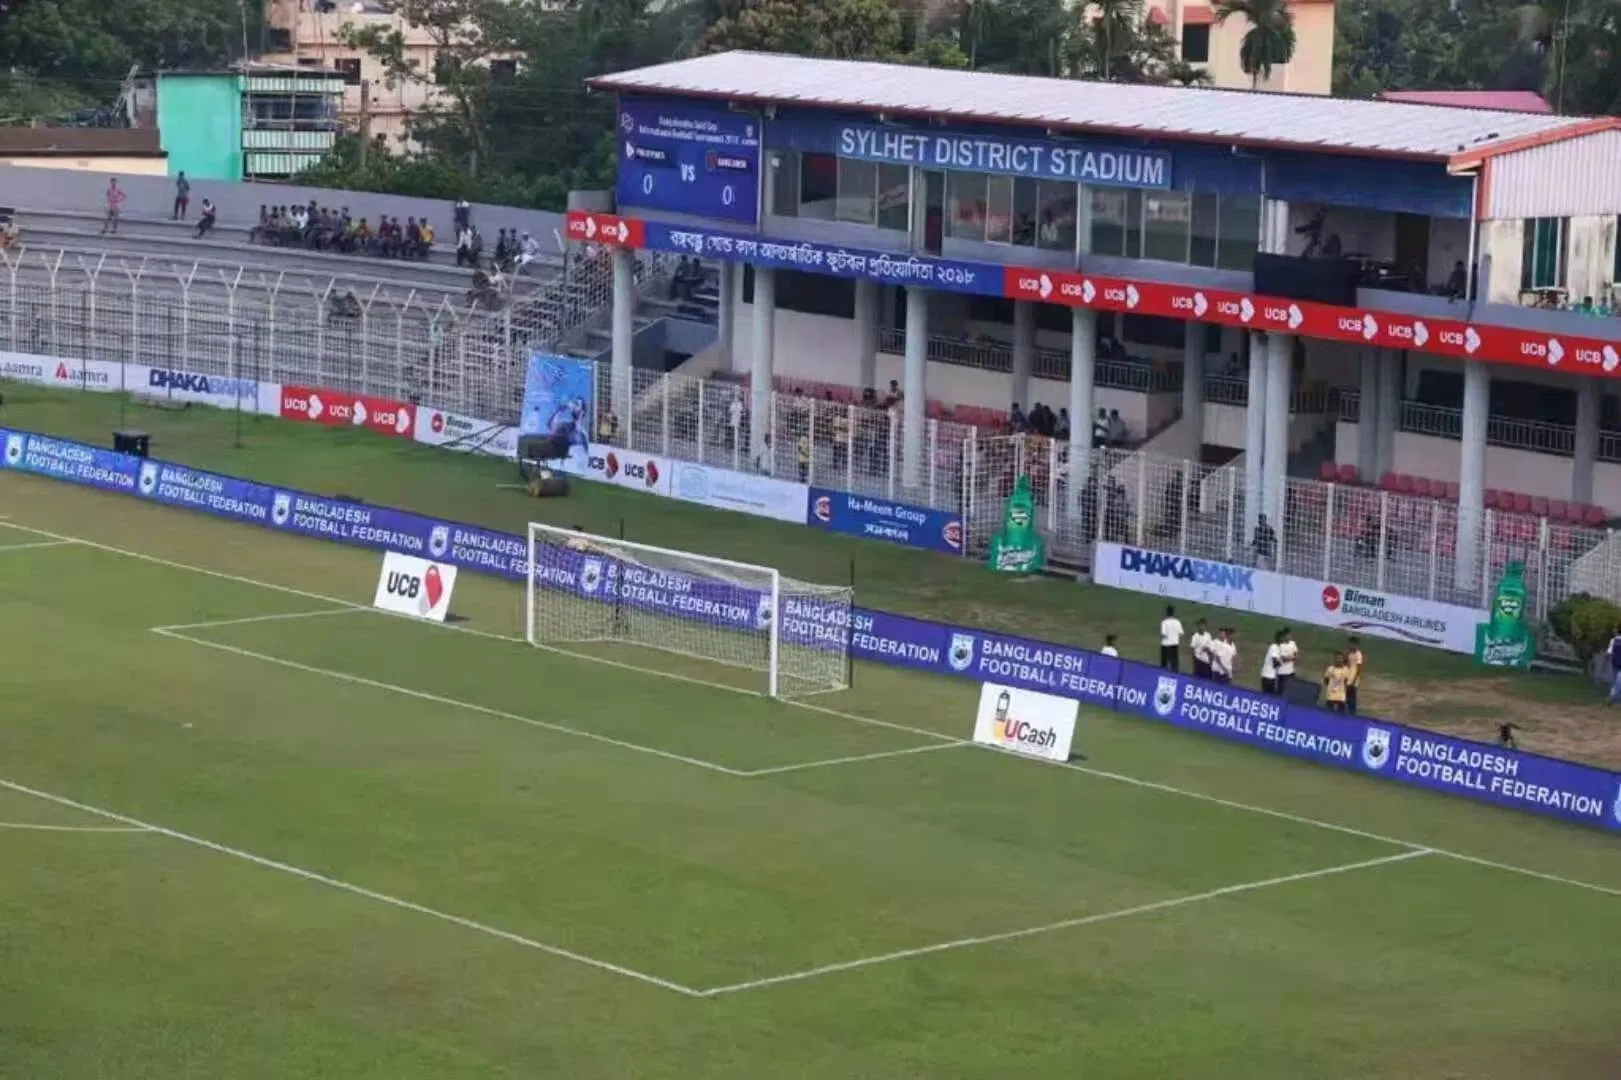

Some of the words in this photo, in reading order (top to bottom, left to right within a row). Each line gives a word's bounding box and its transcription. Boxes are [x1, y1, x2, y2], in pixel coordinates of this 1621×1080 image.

[841, 127, 929, 162] SYLHET
[935, 137, 1044, 177] DISTRICT
[1050, 147, 1165, 185] STADIUM
[643, 173, 653, 195] 0
[681, 163, 696, 182] VS
[722, 185, 733, 205] 0
[937, 266, 975, 285] ২০১৮
[1019, 278, 1039, 290] UCB
[1061, 283, 1082, 296] UCB
[1104, 288, 1125, 301] UCB
[1172, 296, 1193, 310] UCB
[1217, 301, 1239, 315] UCB
[1264, 306, 1287, 321] UCB
[1338, 318, 1362, 331] UCB
[1388, 324, 1412, 339] UCB
[1439, 331, 1464, 345] UCB
[1520, 342, 1546, 357] UCB
[1575, 349, 1601, 364] UCB
[284, 397, 307, 411] UCB
[373, 412, 396, 425] UCB
[27, 435, 93, 464] BANGLADESH
[25, 453, 76, 477] FOOTBALL
[77, 465, 135, 488] FEDERATION
[160, 466, 223, 494] BANGLADESH
[624, 463, 645, 479] UCB
[158, 482, 207, 507] FOOTBALL
[208, 495, 267, 520] FEDERATION
[295, 499, 371, 525] BANGLADESH
[895, 506, 926, 525] Group
[293, 513, 348, 537] FOOTBALL
[350, 525, 423, 551] FEDERATION
[454, 531, 527, 557] BANGLADESH
[451, 545, 508, 571] FOOTBALL
[510, 557, 576, 585] FEDRATION
[387, 572, 421, 599] UCB
[1344, 588, 1385, 607] Biman
[671, 591, 750, 621] FEDERATION
[784, 600, 874, 632] BANGLADESH
[1341, 603, 1402, 624] BANGLADESH
[1404, 613, 1447, 632] AIRLINES
[783, 617, 849, 645] FOOTBALL
[852, 632, 939, 663] FEDERATION
[982, 639, 1083, 672] BANGLADESH
[979, 657, 1057, 687] FOOTBALL
[1059, 672, 1148, 706] FEDERATION
[1183, 684, 1281, 721] BANGLADESH
[1004, 718, 1057, 748] UCash
[1180, 701, 1254, 735] FOOTBALL
[1256, 720, 1354, 760] FEDERATION
[1399, 735, 1519, 777] BANGLADESH
[1396, 755, 1487, 792] FOOTBALL
[1490, 774, 1602, 817] FEDERATION
